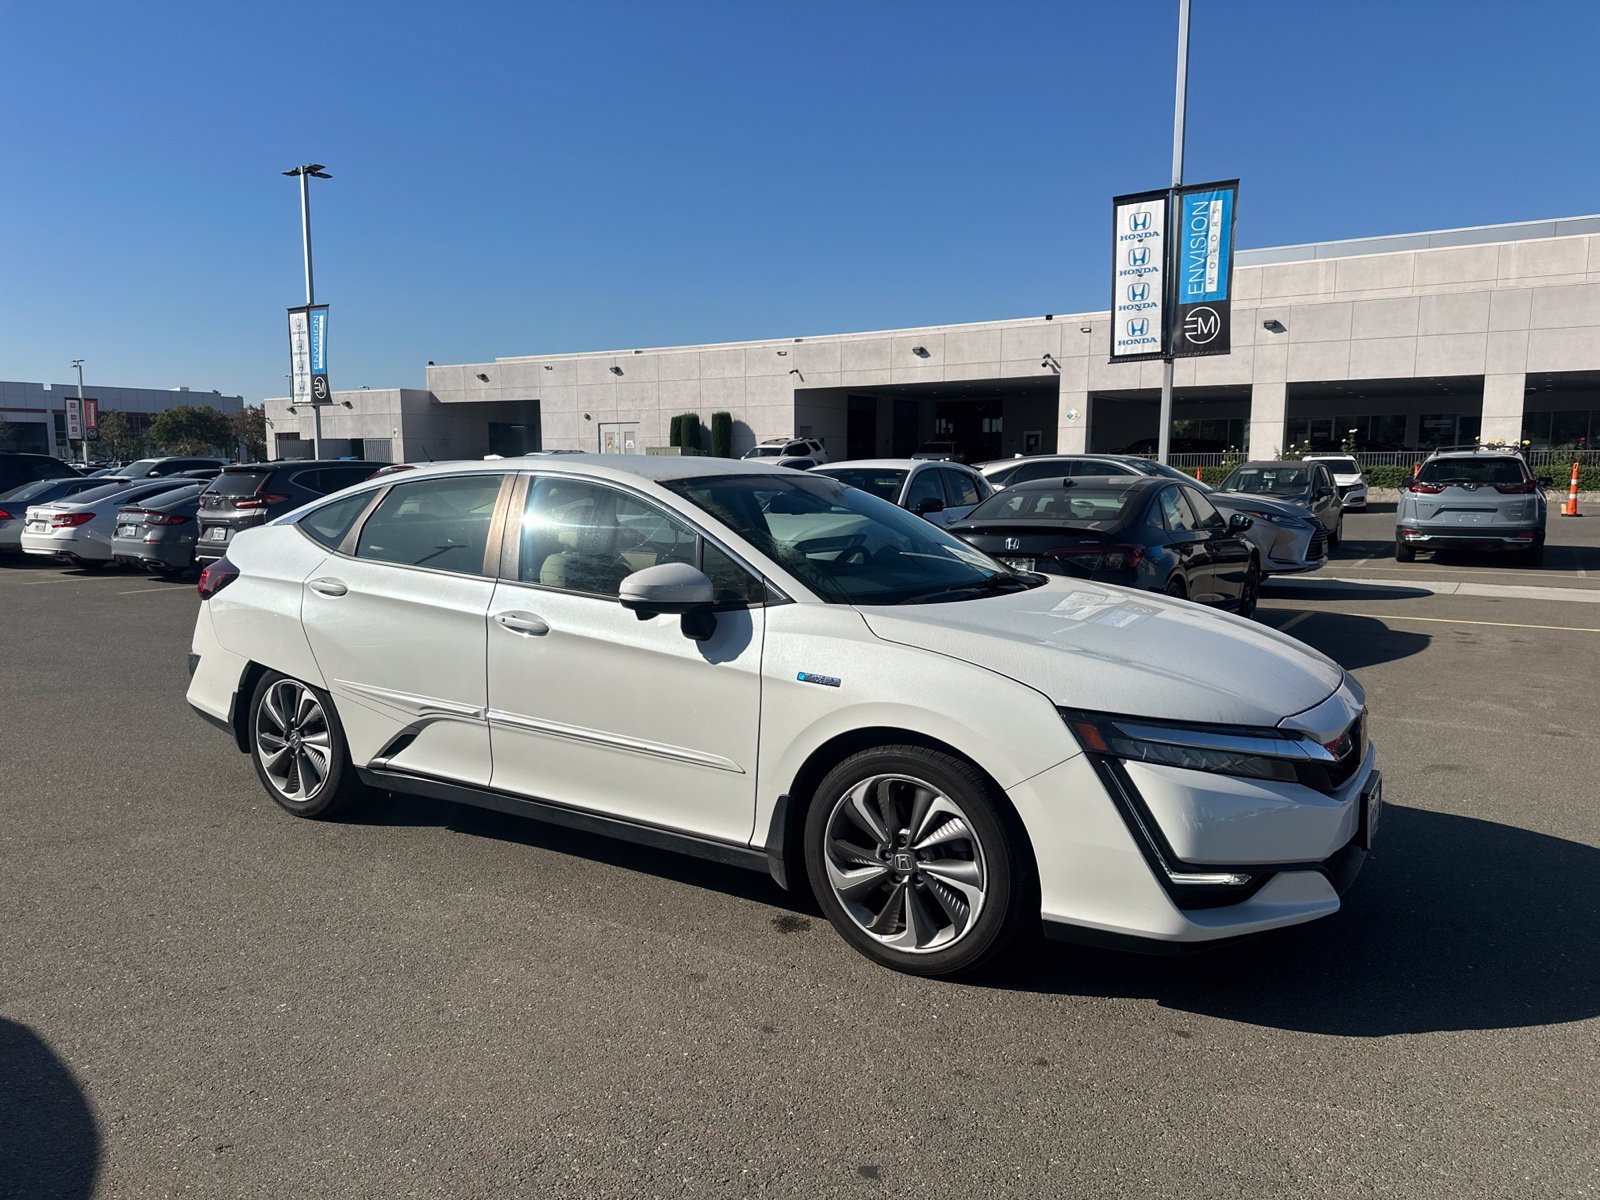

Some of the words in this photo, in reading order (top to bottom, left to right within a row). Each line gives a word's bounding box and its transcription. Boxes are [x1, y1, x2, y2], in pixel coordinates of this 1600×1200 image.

[1120, 231, 1160, 241] HONDA
[1188, 201, 1209, 295] ENVISION
[1119, 266, 1159, 276] HONDA
[1118, 302, 1158, 311] HONDA
[1117, 337, 1157, 346] HONDA
